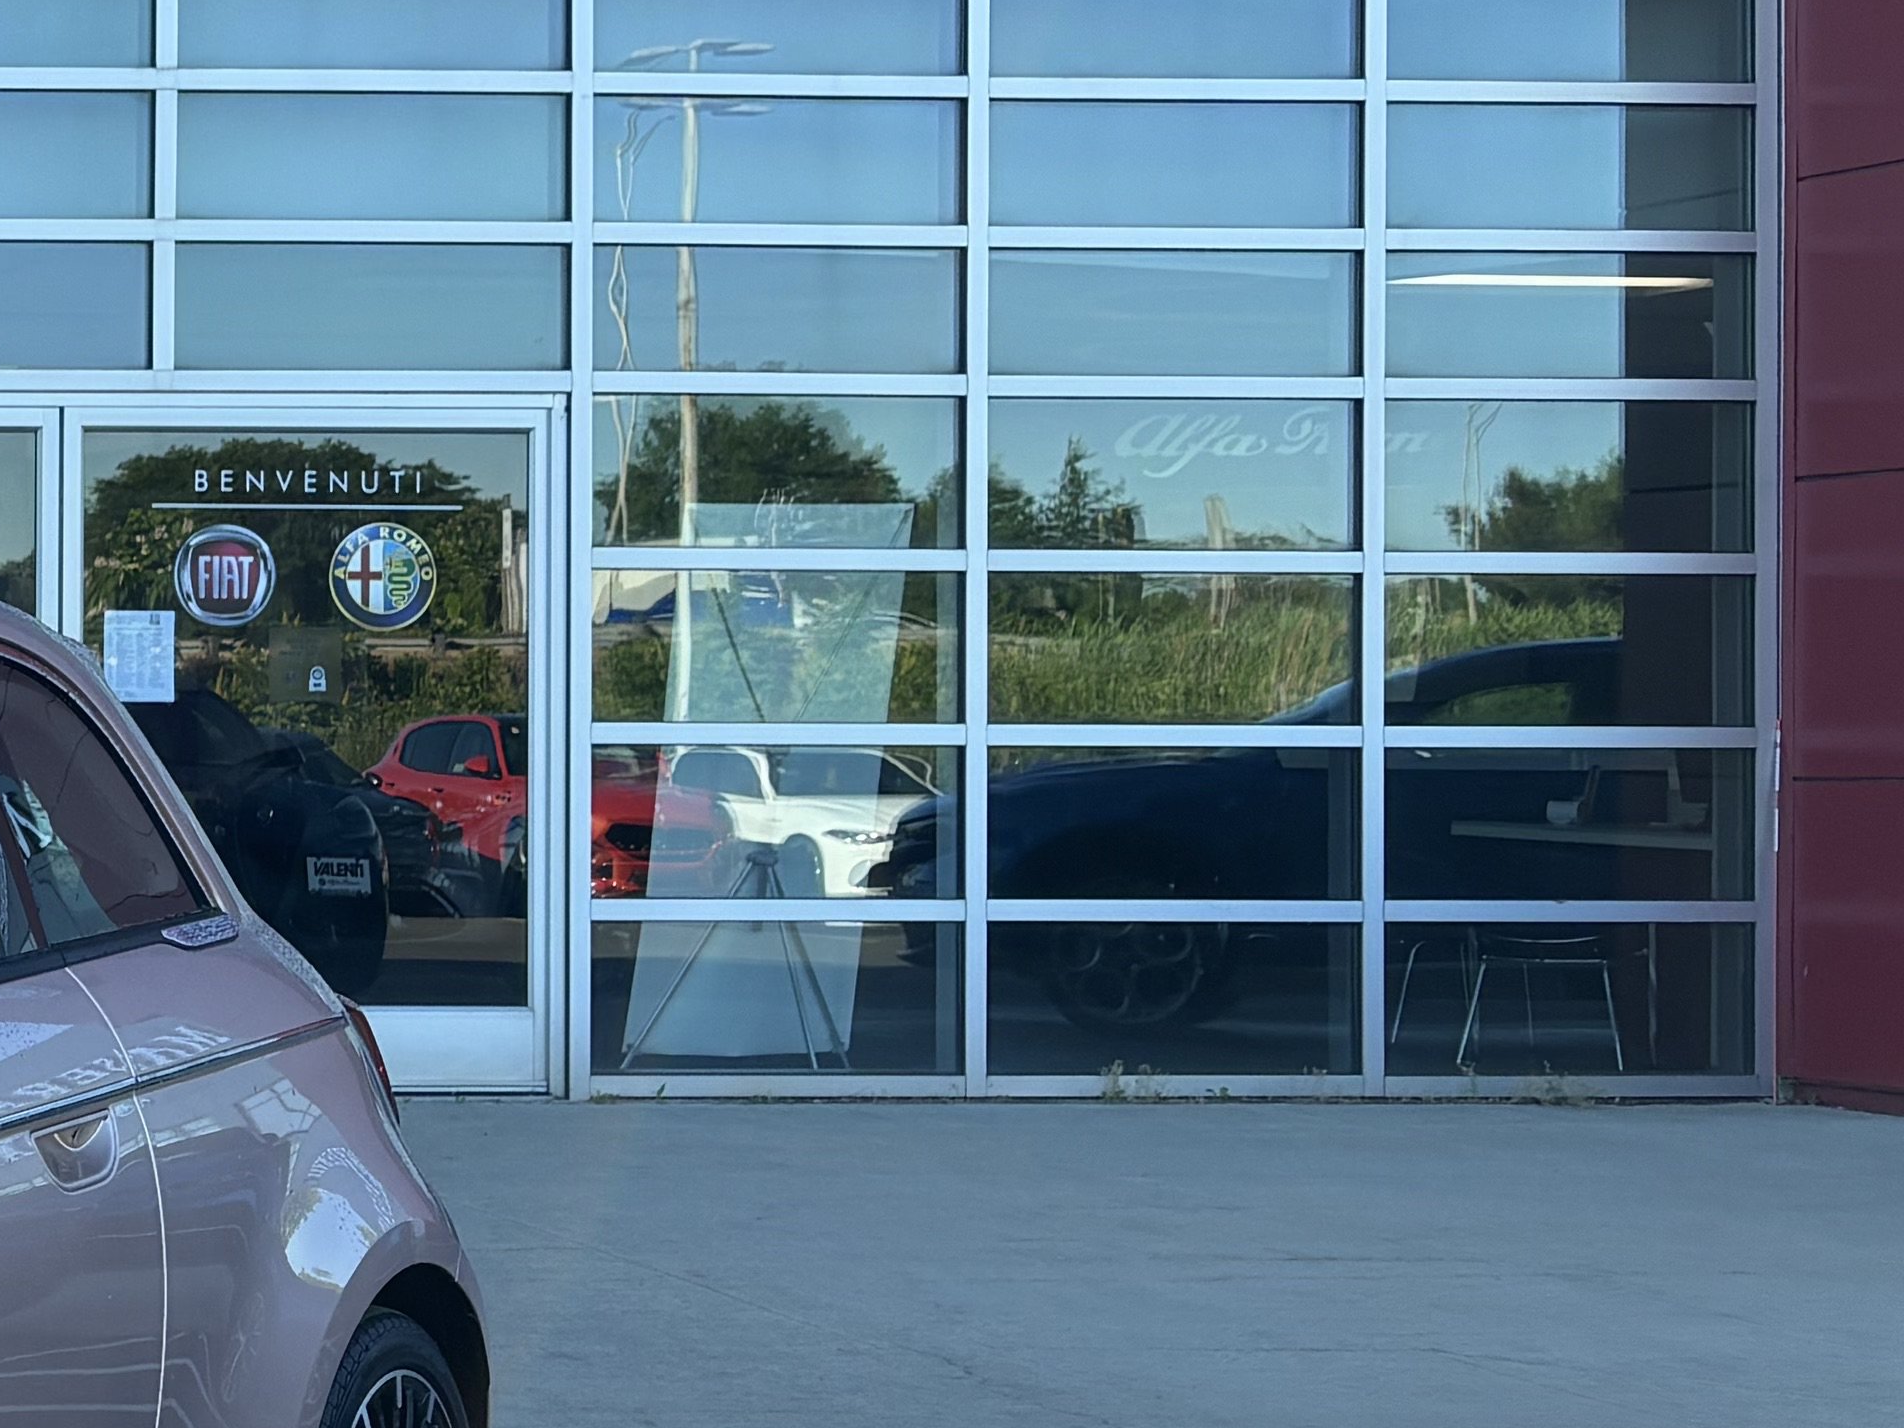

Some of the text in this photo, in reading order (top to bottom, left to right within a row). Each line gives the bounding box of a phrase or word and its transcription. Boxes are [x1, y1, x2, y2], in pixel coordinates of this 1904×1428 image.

[1114, 412, 1268, 479] Alfa
[193, 468, 426, 496] BENVENUTI
[197, 553, 258, 601] FIAT
[334, 526, 433, 581] ALFA ROMEO
[313, 860, 365, 879] VALENTI
